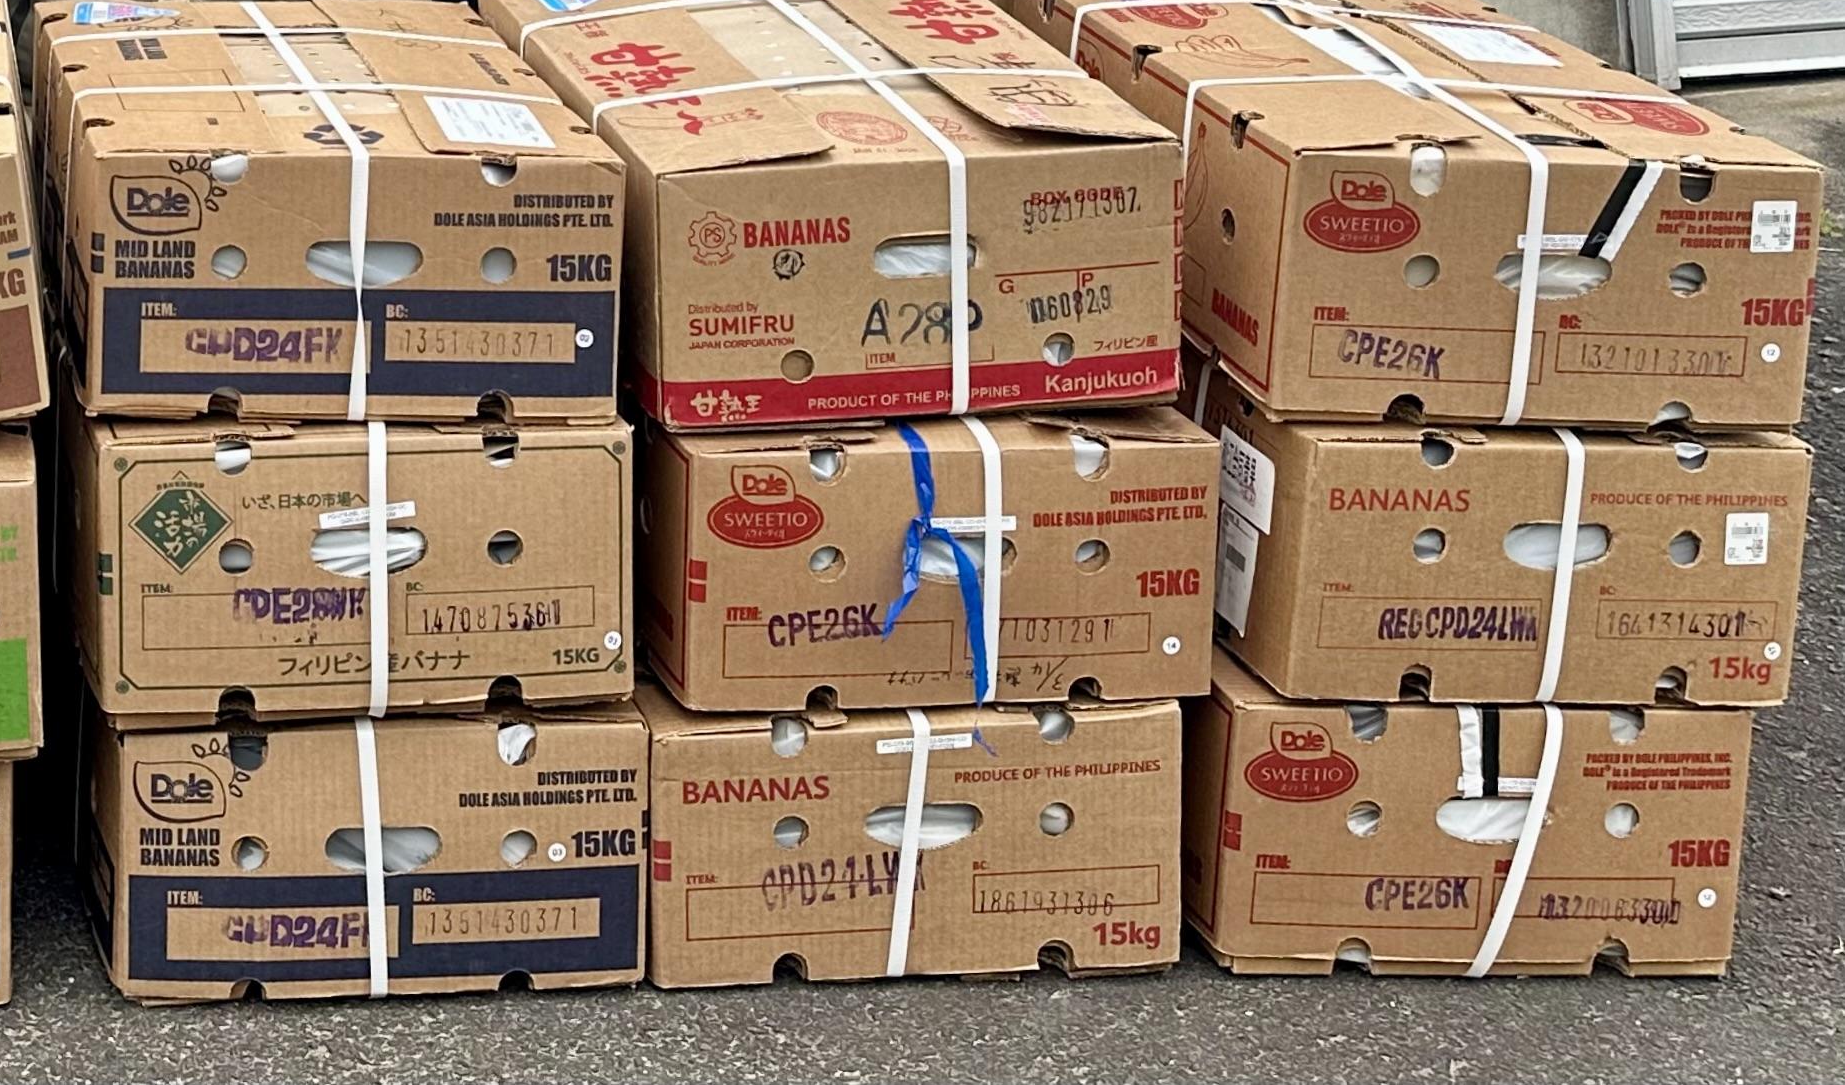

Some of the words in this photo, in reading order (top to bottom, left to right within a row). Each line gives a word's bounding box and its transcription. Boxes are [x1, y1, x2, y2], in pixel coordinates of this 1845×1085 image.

[127, 187, 190, 211] Dole
[1341, 179, 1388, 202] Dole
[514, 194, 596, 209] DISTRIBUTED
[597, 194, 614, 209] BY
[434, 212, 466, 227] DOLE
[467, 212, 496, 227] ASIA
[498, 212, 560, 227] HOLDINGS
[563, 213, 588, 228] PTE.
[590, 213, 614, 228] LTD.
[1320, 216, 1406, 233] SWEETIO
[743, 217, 851, 248] BANANAS
[115, 240, 148, 258] MID
[153, 240, 196, 258] LAND
[115, 261, 195, 279] BANANAS
[546, 254, 613, 282] 15KG
[998, 278, 1015, 294] G
[1081, 271, 1095, 288] P
[141, 302, 177, 317] ITEM:
[385, 304, 409, 319] BC:
[688, 302, 744, 315] Distributed
[746, 301, 759, 315] by
[1313, 306, 1350, 322] ITEM:
[1741, 298, 1805, 326] 15KG
[689, 315, 795, 337] SUMIFRU
[689, 340, 722, 350] JAPAN
[723, 337, 795, 350] CORPORATION
[869, 353, 896, 364] ITEM
[1338, 329, 1446, 380] CPE26K
[1045, 366, 1158, 395] Kanjukuoh
[807, 395, 876, 411] PRODUCT
[881, 394, 901, 406] OF
[906, 392, 932, 404] THE
[742, 474, 787, 496] Dole
[1110, 486, 1189, 504] DISTRIBUTED
[1190, 485, 1208, 500] BY
[242, 491, 368, 511] いざ、日本の市場へ
[1328, 488, 1471, 513] BANANAS
[1590, 493, 1653, 505] PRODUCE
[1656, 493, 1673, 505] OF
[1677, 494, 1702, 506] THE
[1705, 494, 1789, 508] PHILIPPINES
[724, 512, 808, 528] SWEETIO
[1033, 512, 1064, 527] DOLE
[1065, 511, 1094, 527] ASIA
[1096, 508, 1155, 525] HOLDINGS
[1157, 507, 1181, 522] PTE.
[1183, 505, 1208, 520] LTD.
[1136, 568, 1201, 598] 15KG
[1322, 582, 1354, 593] ITEM:
[726, 606, 762, 622] ITEM:
[767, 603, 882, 647] CPE26K
[552, 647, 600, 667] 15KG
[1709, 656, 1772, 686] 15kg
[1281, 731, 1325, 752] Dole
[537, 769, 619, 786] DISTRIBUTED
[620, 769, 637, 784] BY
[955, 768, 1019, 784] PRODUCE
[1022, 767, 1041, 781] OF
[1046, 765, 1072, 779] THE
[1074, 759, 1161, 777] PHILIPPINES
[1261, 766, 1344, 783] SWEETIO
[151, 773, 214, 798] Dole
[682, 775, 830, 804] BANANAS
[459, 792, 490, 808] DOLE
[491, 791, 521, 807] ASIA
[523, 789, 584, 807] HOLDINGS
[586, 788, 611, 804] PTE.
[613, 787, 638, 803] LTD.
[140, 828, 173, 846] MID
[177, 828, 221, 846] LAND
[571, 828, 636, 859] 15KG
[140, 848, 221, 867] BANANAS
[1256, 854, 1291, 870] ITEM:
[1668, 840, 1731, 868] 15KG
[686, 875, 719, 885] ITEM:
[167, 889, 203, 905] ITEM:
[413, 887, 436, 903] BC:
[1365, 877, 1470, 911] CPE26K
[1092, 920, 1161, 950] 15kg
